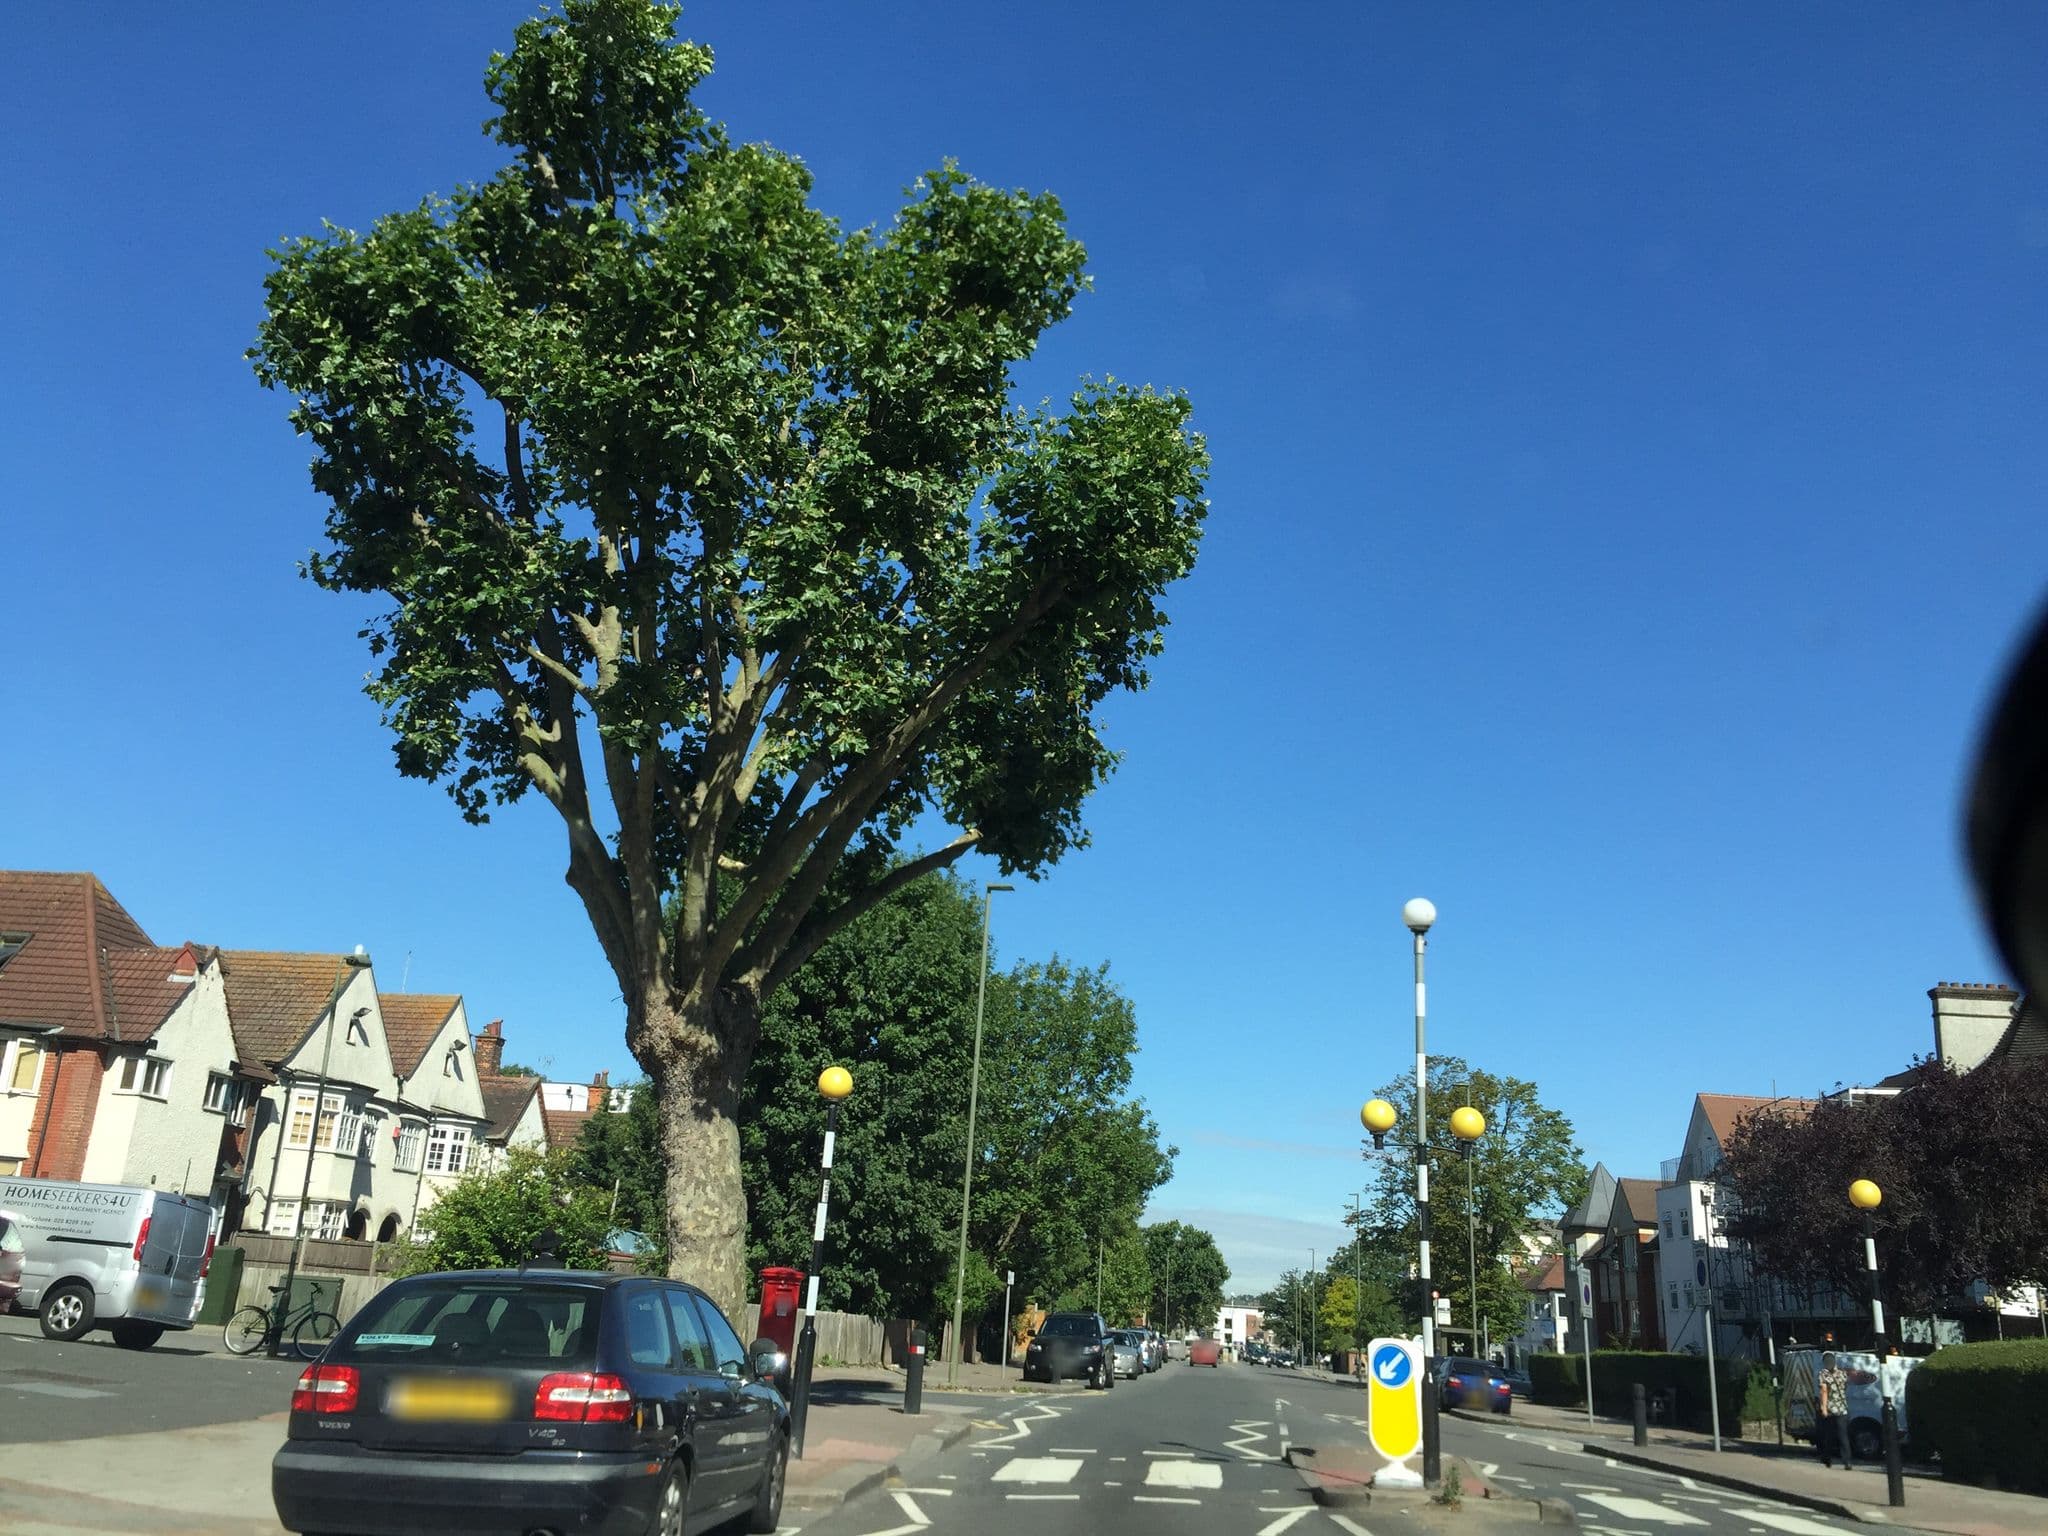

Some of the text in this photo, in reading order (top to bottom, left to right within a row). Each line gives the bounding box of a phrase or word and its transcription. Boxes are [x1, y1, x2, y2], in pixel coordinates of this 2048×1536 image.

[4, 1186, 131, 1207] HOMESEEKERS4U
[61, 1205, 100, 1213] MANAGEMENT
[318, 1420, 351, 1430] VOLVO
